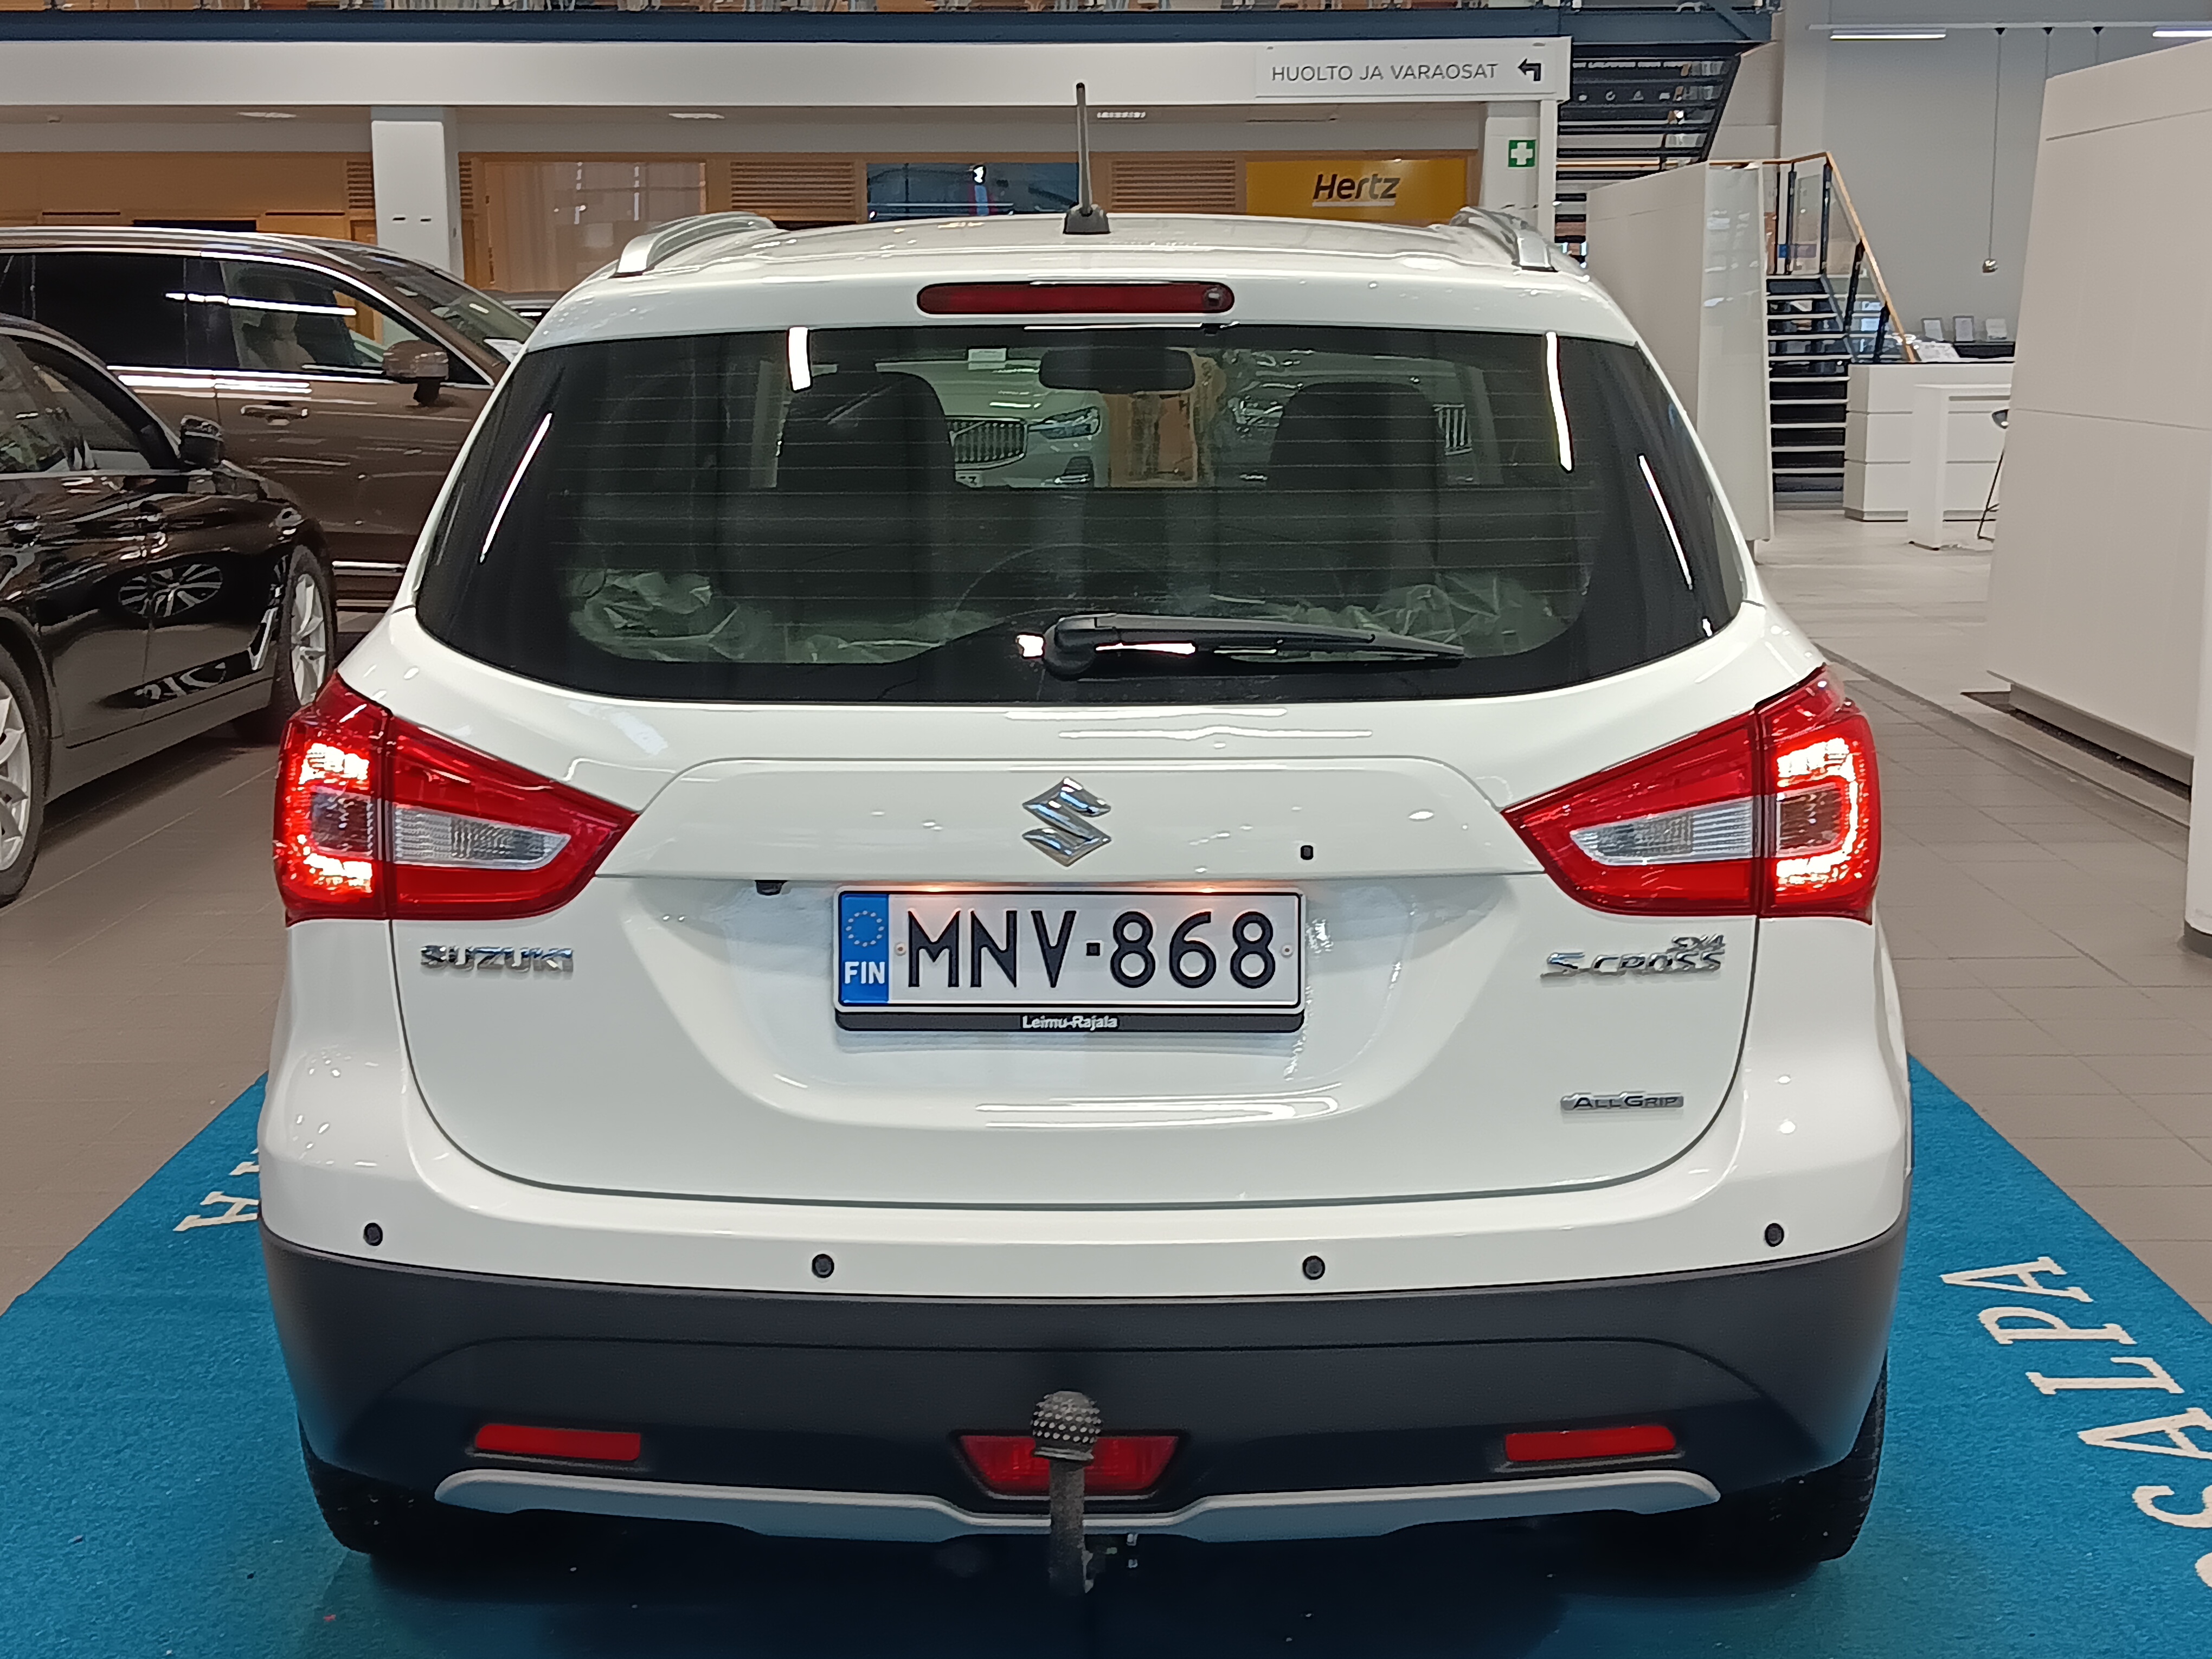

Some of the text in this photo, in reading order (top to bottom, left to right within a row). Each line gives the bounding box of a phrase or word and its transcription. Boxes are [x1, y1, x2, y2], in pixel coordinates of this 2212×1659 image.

[1271, 63, 1500, 82] HUOLTO JA VARAOSAT
[1312, 173, 1401, 200] Hertz
[420, 945, 574, 973] SUZUKI
[907, 909, 1276, 989] MNV-868
[844, 961, 885, 984] FIN
[1022, 1014, 1118, 1031] Leimu-Rajala
[1940, 1256, 2212, 1590] SALPA
